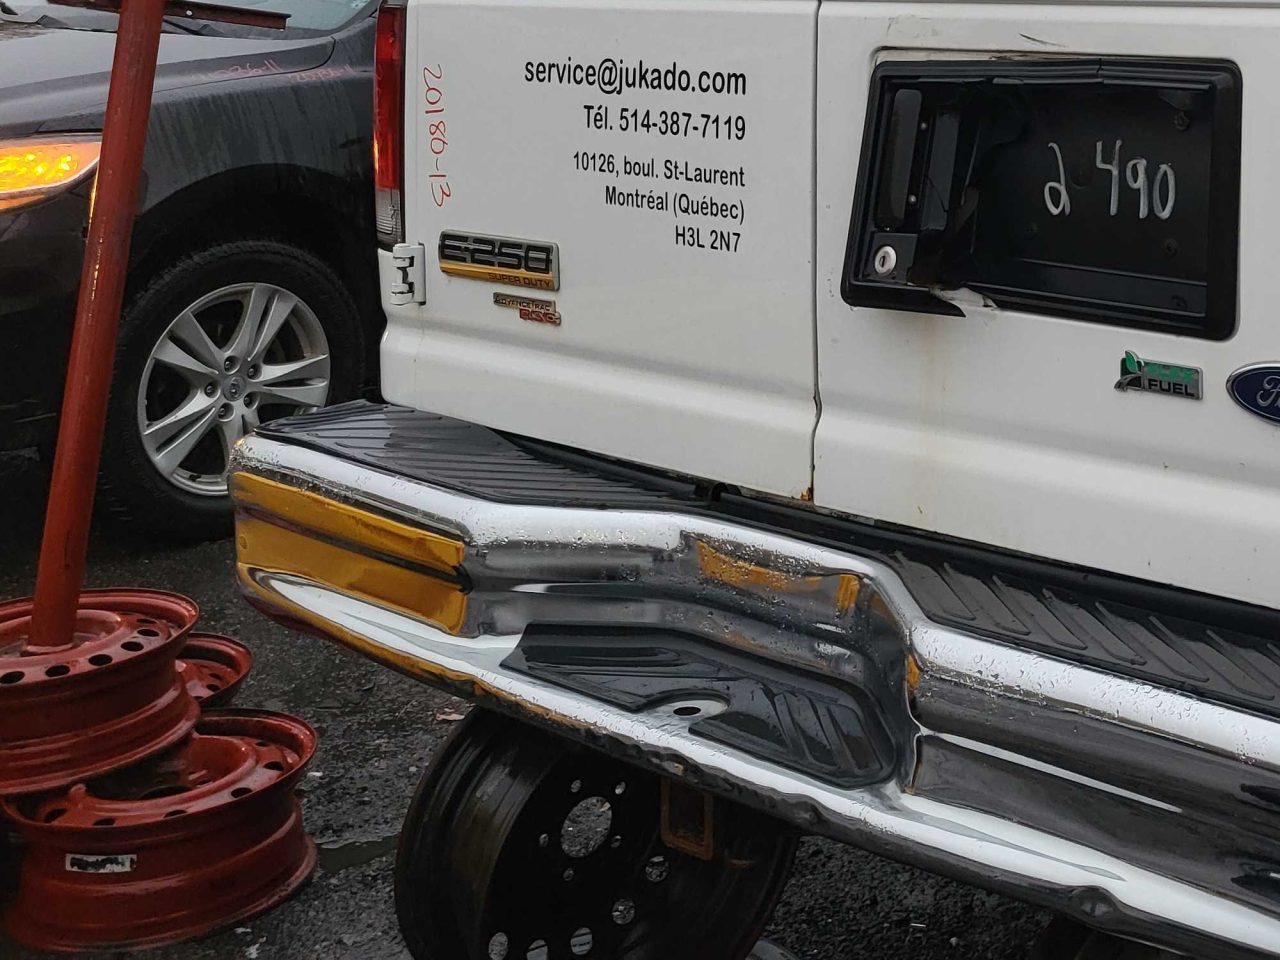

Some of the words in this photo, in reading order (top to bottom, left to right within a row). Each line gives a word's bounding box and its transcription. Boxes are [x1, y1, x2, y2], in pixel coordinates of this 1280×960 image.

[524, 56, 747, 95] service@jukado.com
[583, 104, 613, 131] Tél.
[619, 107, 747, 141] 514-387-7119
[573, 151, 619, 178] 10126,
[624, 155, 659, 179] boul.
[664, 159, 746, 187] St-Laurent
[605, 185, 668, 211] Montréal
[673, 192, 745, 226] (Québec)
[675, 225, 705, 249] H3L
[710, 229, 741, 253] 2N7
[488, 272, 522, 285] SUPER
[523, 278, 551, 289] DUTY
[1147, 378, 1196, 398] FUEL
